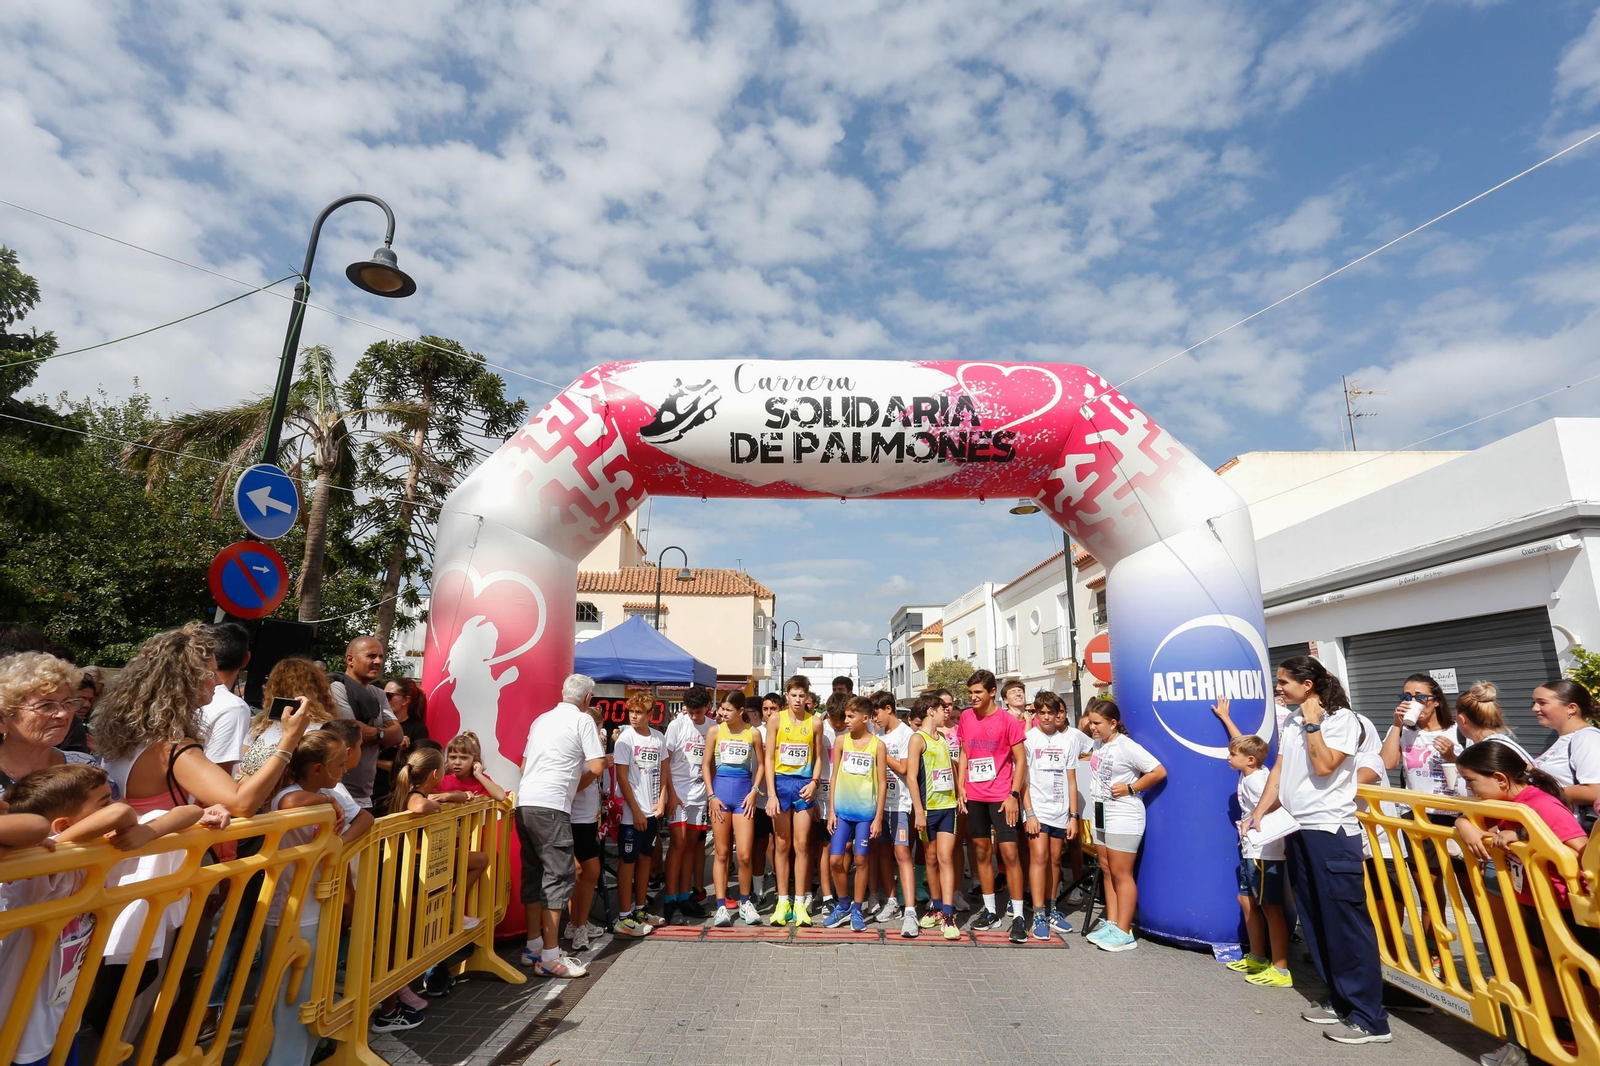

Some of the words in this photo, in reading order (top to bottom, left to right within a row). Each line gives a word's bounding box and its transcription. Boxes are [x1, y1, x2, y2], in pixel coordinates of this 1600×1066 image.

[734, 363, 857, 394] Carrera
[764, 396, 981, 430] SOLIDARIA
[730, 431, 785, 464] DE
[793, 430, 1017, 465] PALMONES
[1521, 544, 1552, 556] Cruzcampo
[1152, 669, 1265, 702] ACERINOX
[641, 752, 658, 761] 289
[728, 748, 748, 756] 529
[788, 750, 807, 758] 453
[851, 757, 870, 767] 166
[1048, 754, 1060, 762] 75
[975, 764, 993, 773] 721
[1386, 971, 1425, 994] Ayuntamiento
[1425, 988, 1440, 1001] Los
[1440, 995, 1471, 1016] Barrios
